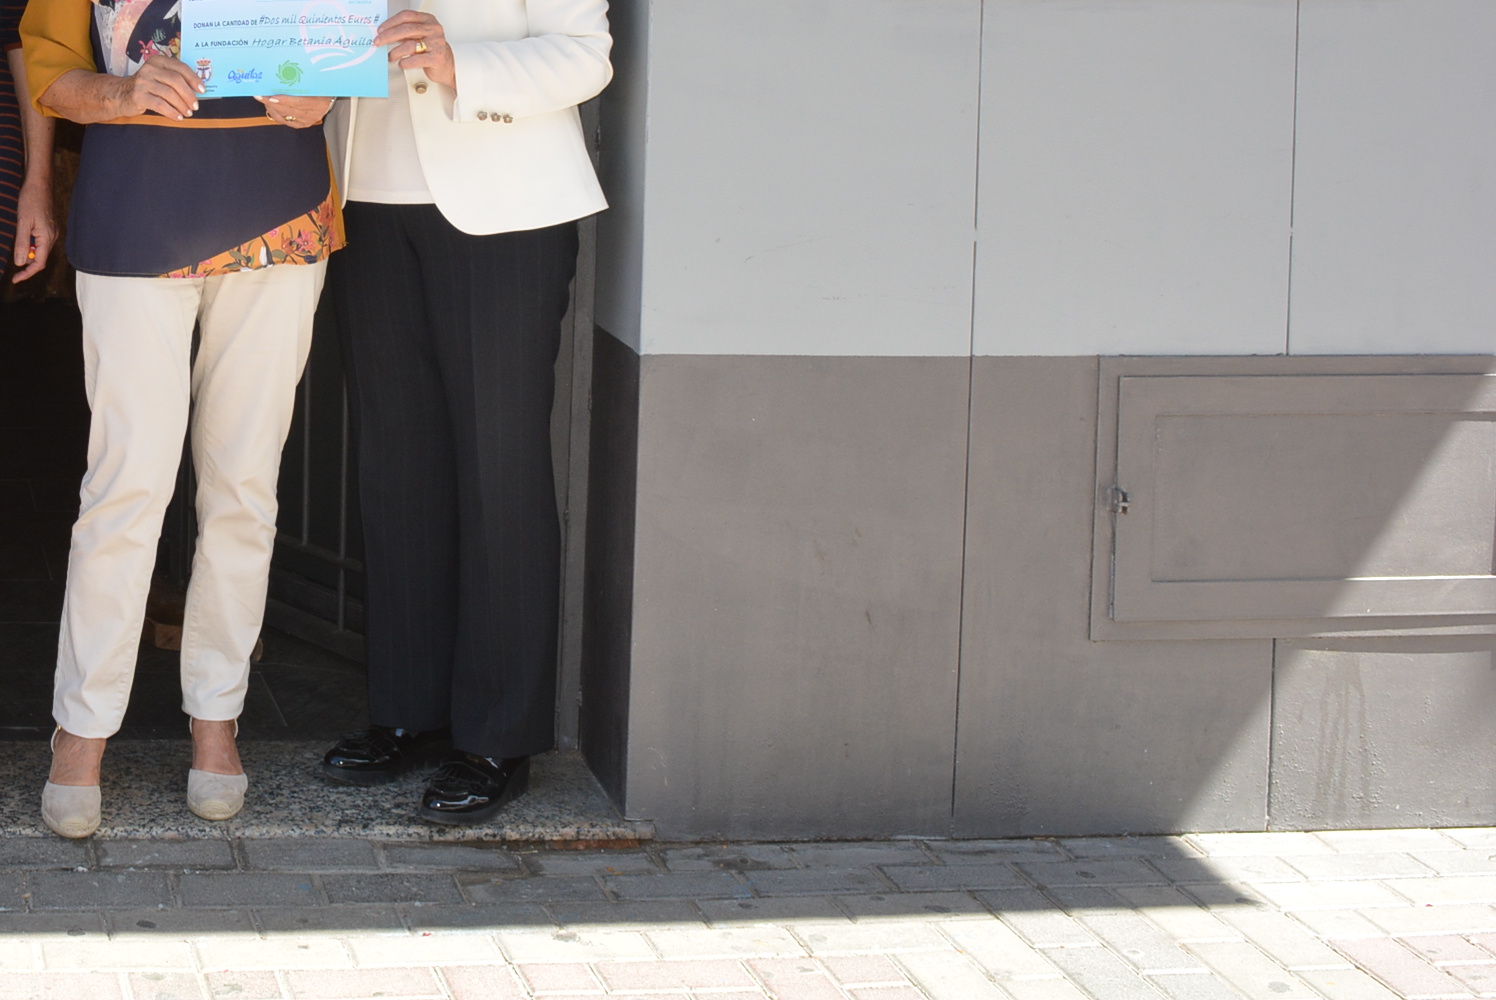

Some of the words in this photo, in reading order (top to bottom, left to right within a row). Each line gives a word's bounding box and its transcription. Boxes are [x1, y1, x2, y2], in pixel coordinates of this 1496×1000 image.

[222, 19, 250, 27] CANTIDAD
[281, 14, 297, 24] mil
[298, 13, 346, 25] Quinientos
[347, 14, 372, 24] Euros
[210, 39, 249, 47] FUNDACIÓN
[252, 37, 288, 49] Hogar
[289, 35, 334, 46] Betania
[334, 35, 375, 49] Águila
